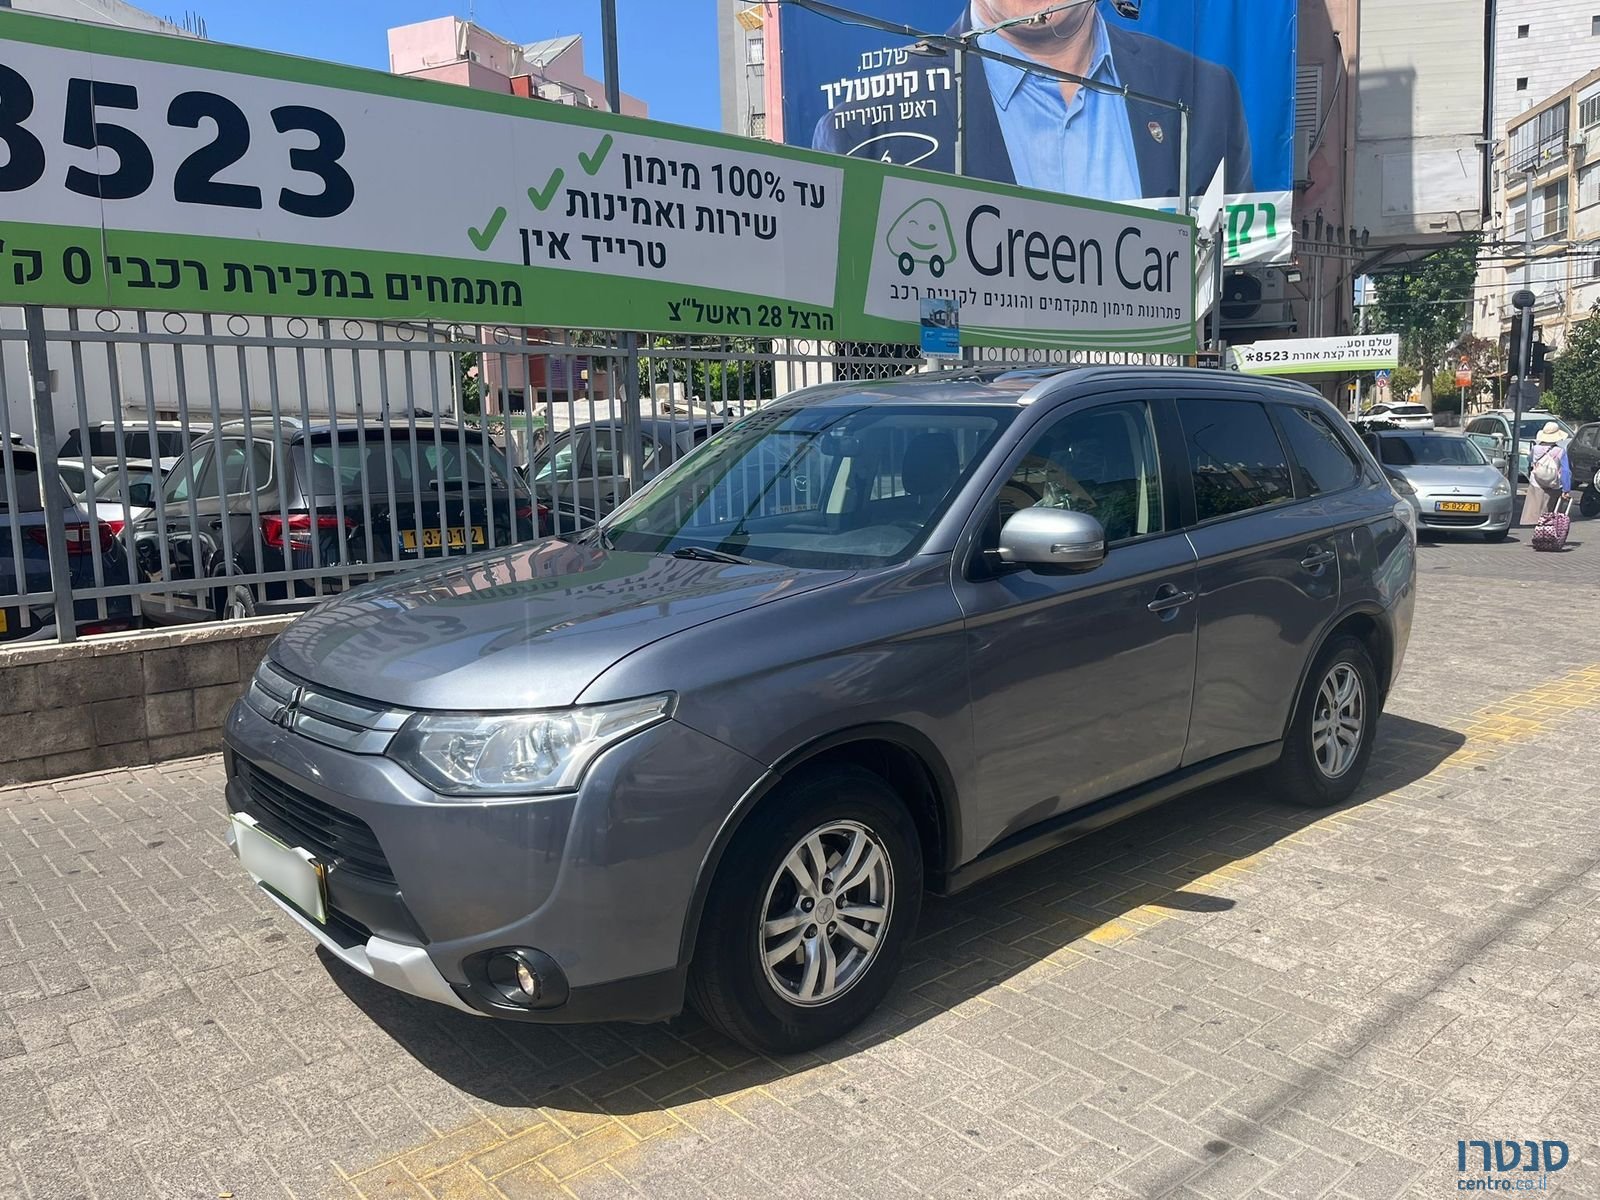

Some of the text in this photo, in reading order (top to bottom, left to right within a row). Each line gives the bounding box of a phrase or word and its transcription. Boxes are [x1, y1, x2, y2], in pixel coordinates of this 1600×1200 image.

[820, 67, 951, 110] רז קינסטליך
[834, 98, 937, 130] ראש העירייה
[622, 153, 826, 208] עד 100% מימון
[566, 188, 777, 240] שירות ואמינות
[519, 228, 667, 269] טרייד אין
[965, 204, 1179, 293] Green Car
[63, 246, 92, 285] 0
[106, 255, 209, 291] רכבי
[224, 263, 374, 300] במכירת
[386, 273, 523, 307] מתמחים
[890, 284, 919, 301] רכב
[983, 293, 1033, 309] והוגנים
[1040, 297, 1098, 316] מתקדמים
[1103, 302, 1133, 318] מימון
[1138, 305, 1181, 320] פתרונות
[758, 304, 783, 328] 28
[788, 306, 834, 331] הרצל
[1347, 350, 1360, 358] זה
[1363, 348, 1392, 357] אצלנו
[1368, 338, 1392, 347] שלם
[1292, 351, 1320, 361] אחרת
[1323, 350, 1345, 360] קצת
